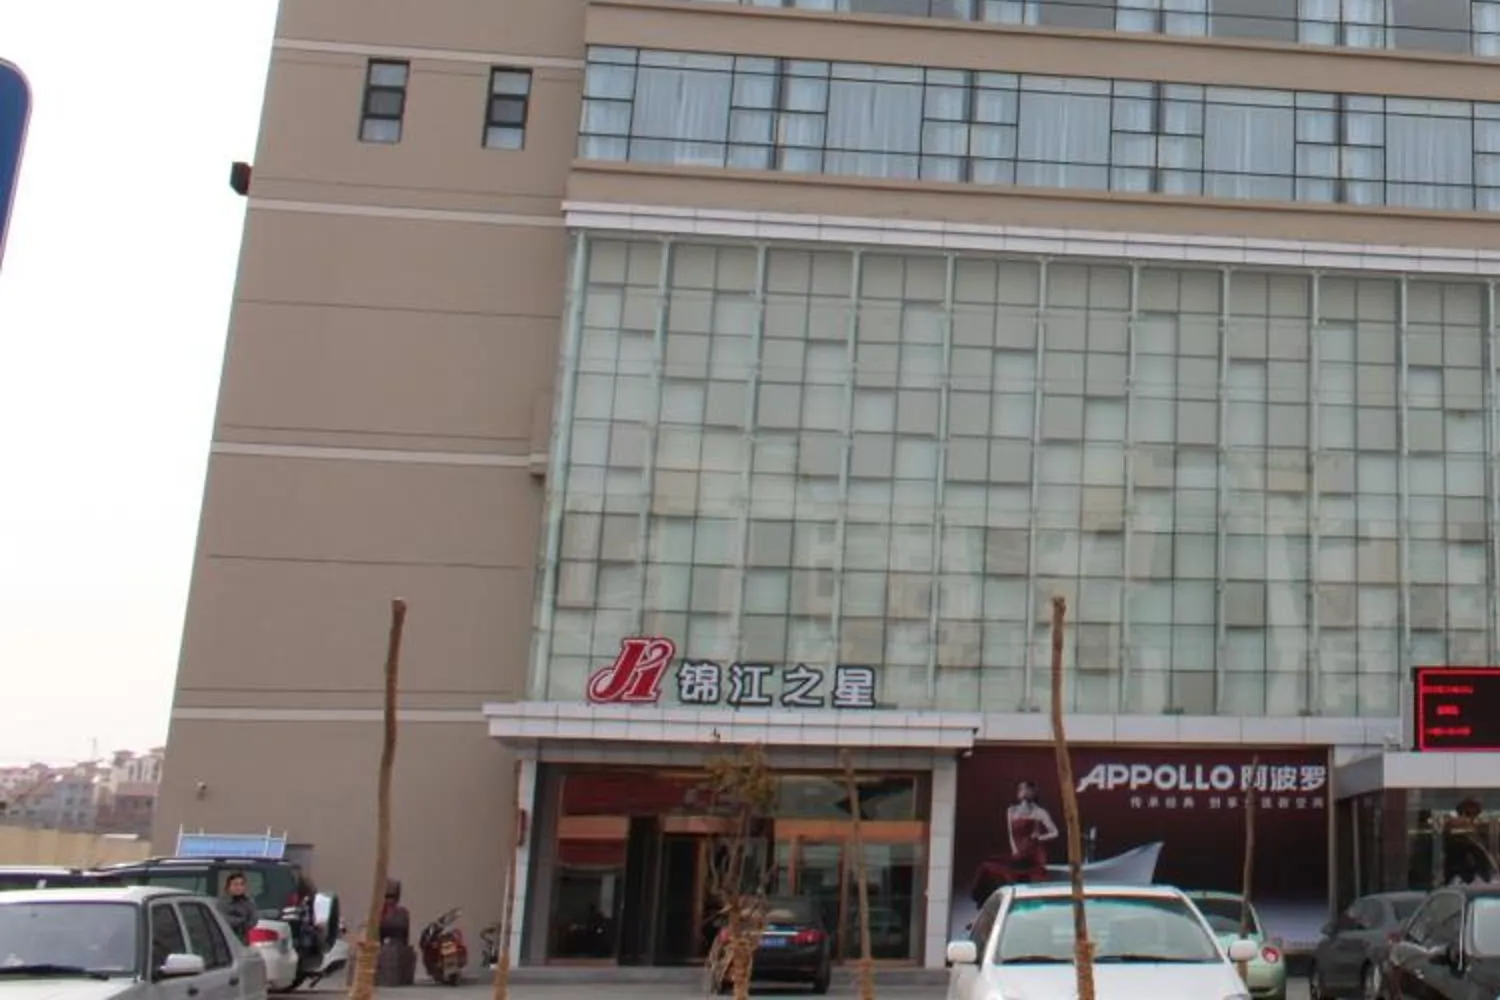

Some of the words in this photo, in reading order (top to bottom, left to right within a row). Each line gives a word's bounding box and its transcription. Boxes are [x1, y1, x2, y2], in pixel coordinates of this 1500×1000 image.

[675, 659, 876, 709] 锦江之星
[1076, 763, 1235, 792] APPOLLO
